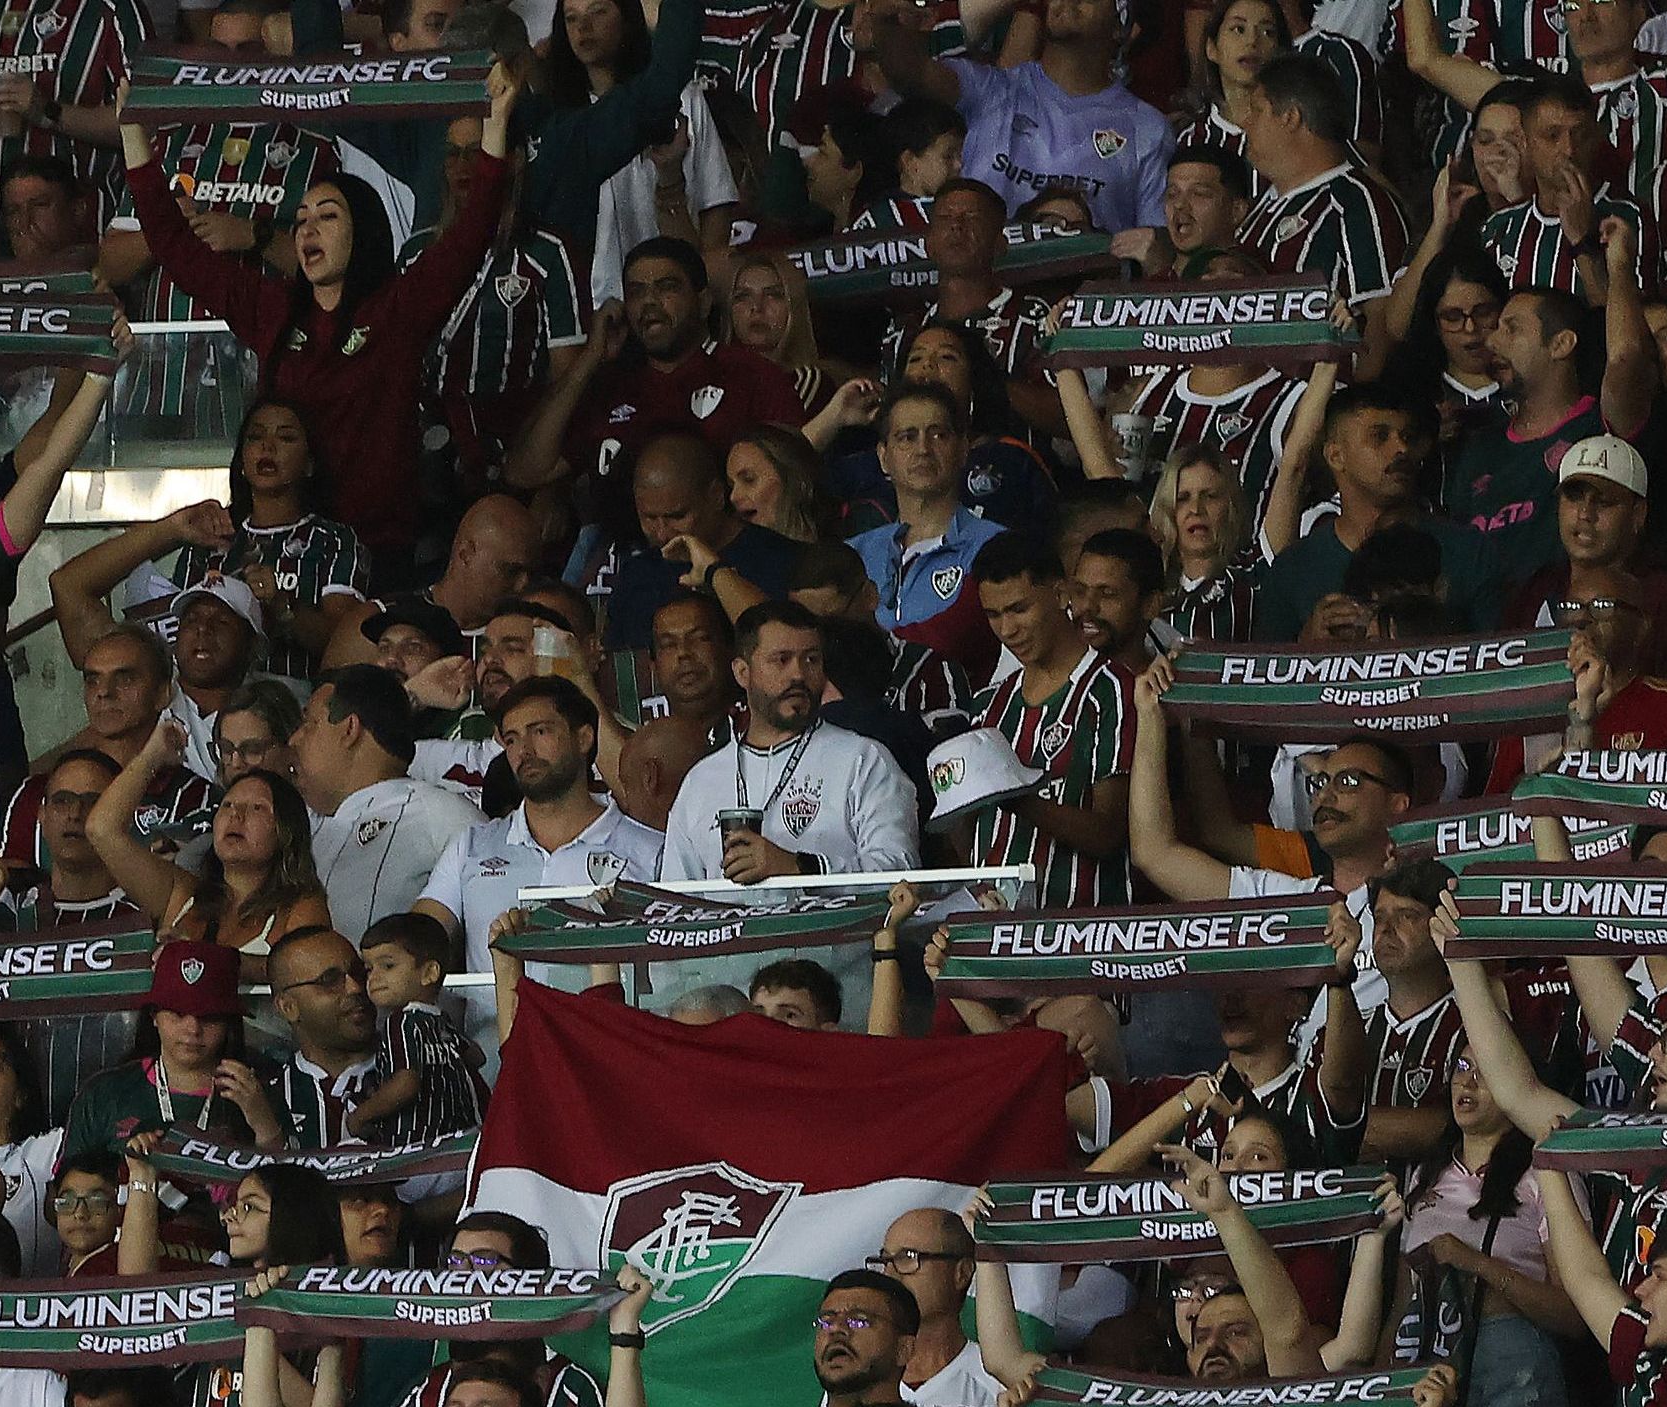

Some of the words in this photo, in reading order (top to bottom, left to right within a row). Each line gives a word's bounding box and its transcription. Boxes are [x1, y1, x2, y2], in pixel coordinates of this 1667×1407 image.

[172, 61, 398, 85] FLUMINENSE
[405, 57, 451, 82] FC
[259, 87, 351, 110] SUPERBET
[195, 181, 285, 205] BETANO
[22, 308, 69, 334] FC
[1058, 294, 1276, 328] FLUMINENSE
[1282, 290, 1327, 321] FC
[1142, 328, 1232, 353] SUPERBET
[1576, 447, 1609, 470] LA
[1220, 645, 1468, 685] FLUMINENSE
[1475, 640, 1526, 668] FC
[1321, 682, 1421, 705] SUPERBET
[1574, 832, 1629, 859] ERBET
[646, 925, 742, 947] SUPERBET
[990, 918, 1230, 954] FLUMINENSE
[1237, 914, 1288, 945] FC
[63, 942, 114, 971] FC
[1091, 957, 1186, 981] SUPERBET
[1032, 1172, 1283, 1217] FLUMINSE
[1291, 1170, 1343, 1197] FC
[1141, 1219, 1218, 1241] SUPERB
[298, 1269, 543, 1295] FLUMINENSE
[551, 1271, 593, 1293] FC
[395, 1300, 493, 1325] SUPERBET
[78, 1330, 187, 1354] SUPERBET
[1081, 1381, 1329, 1407] FLUMINENSE
[1336, 1377, 1391, 1402] FC
